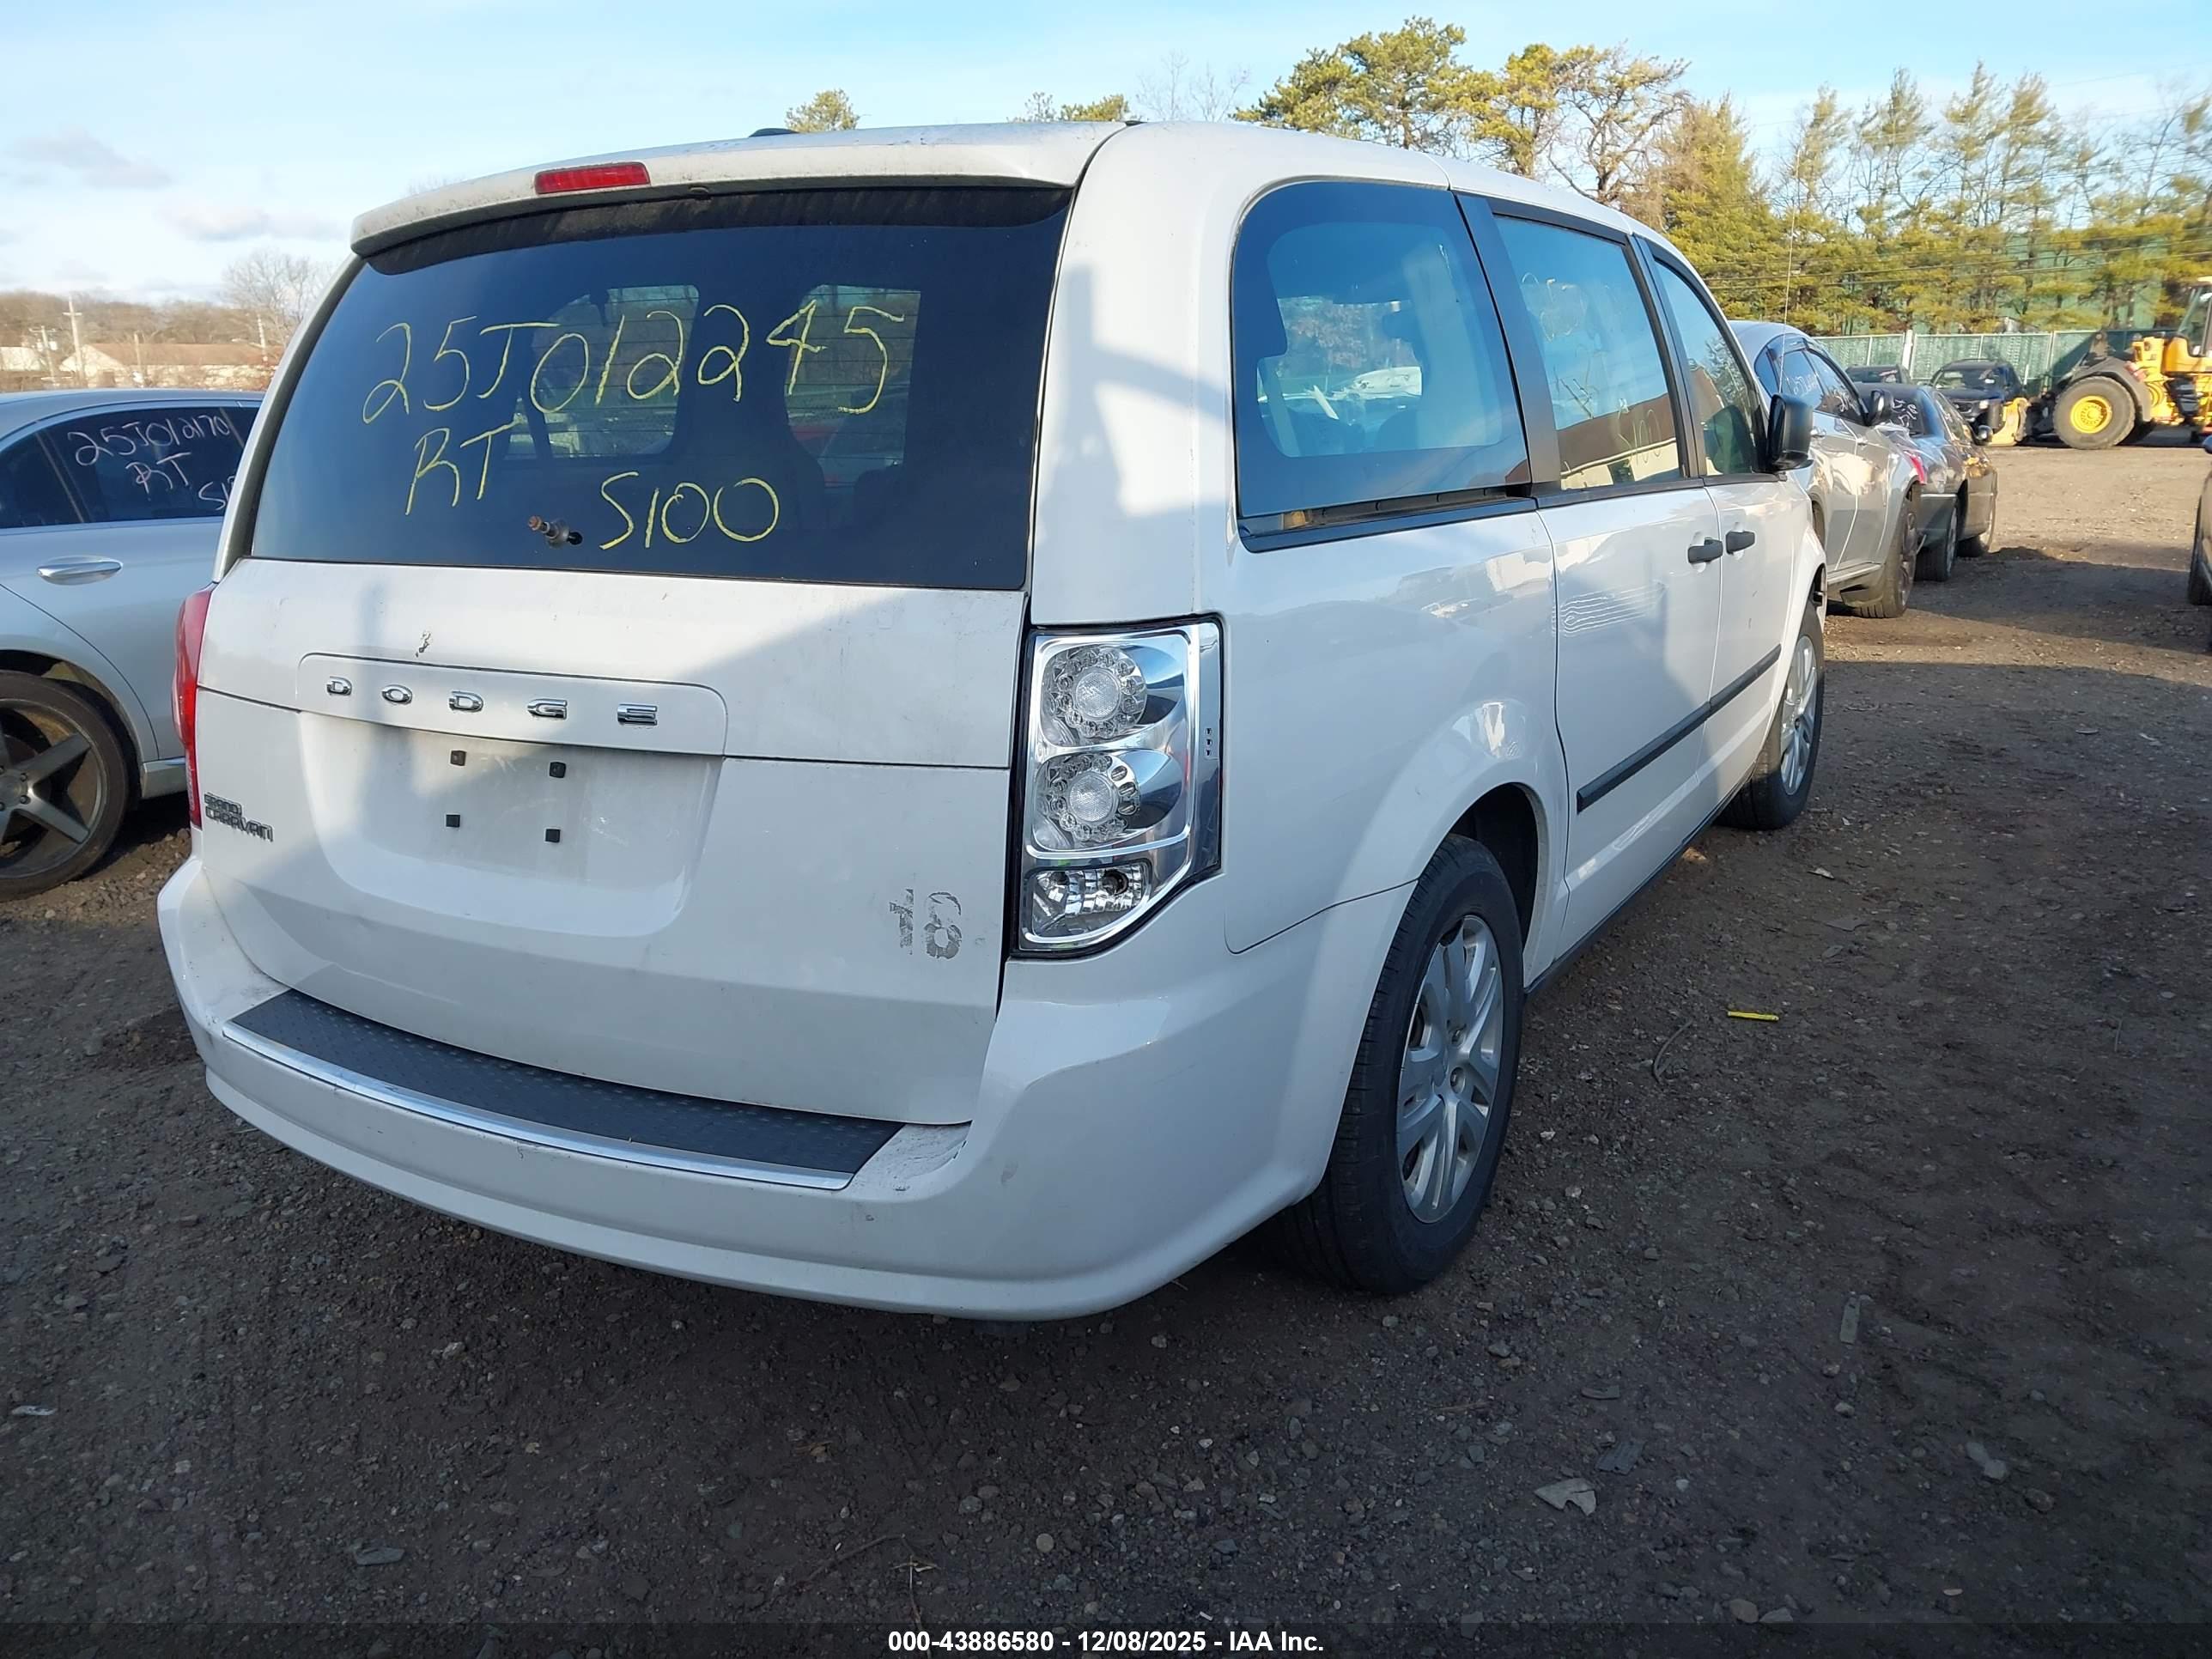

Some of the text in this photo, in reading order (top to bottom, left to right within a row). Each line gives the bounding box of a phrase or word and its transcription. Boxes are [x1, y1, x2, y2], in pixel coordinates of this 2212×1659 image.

[404, 419, 525, 516] RT
[599, 471, 780, 550] S100
[325, 675, 659, 727] DODGE
[205, 805, 274, 842] CARAVAN
